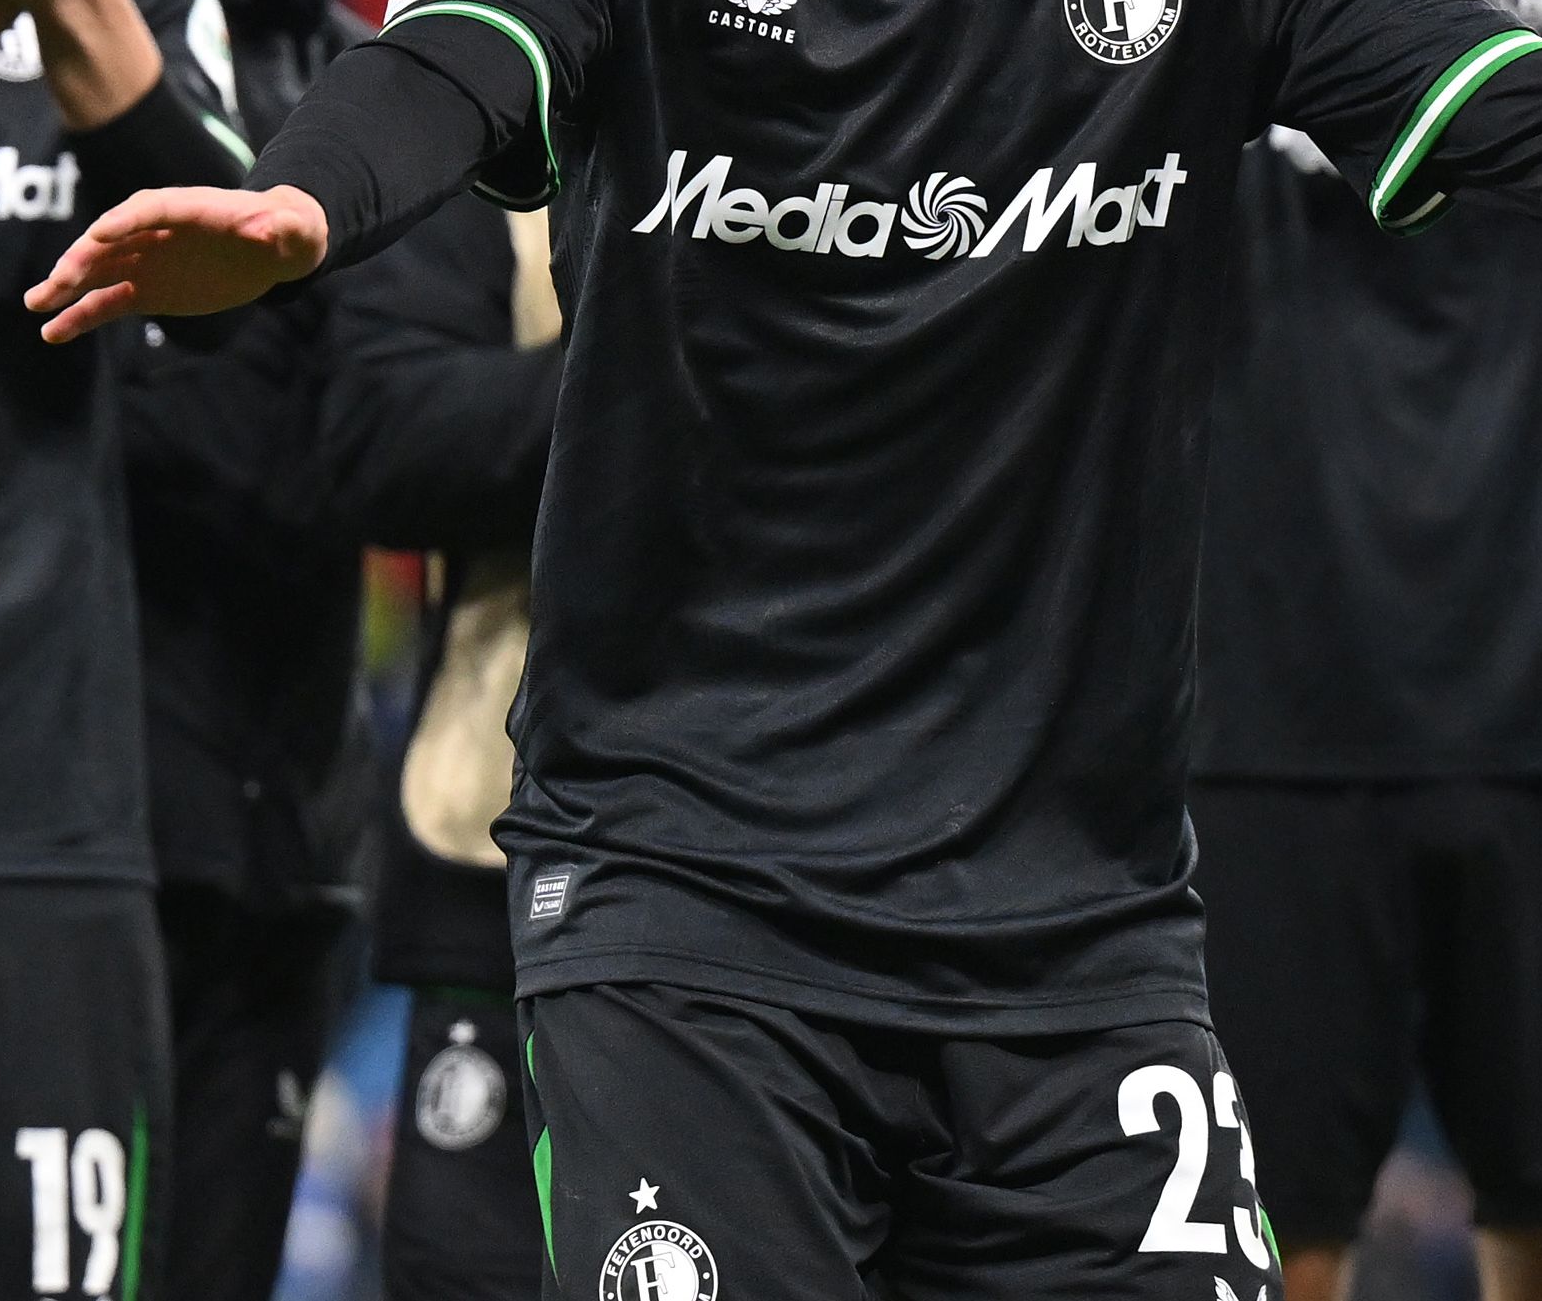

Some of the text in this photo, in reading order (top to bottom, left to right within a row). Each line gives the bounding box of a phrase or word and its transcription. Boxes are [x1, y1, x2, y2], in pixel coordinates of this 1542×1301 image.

[708, 9, 796, 44] CASTORE
[1075, 7, 1177, 59] ROTTERDAM
[631, 149, 899, 259] Media
[14, 1126, 127, 1297] 19
[606, 1225, 704, 1277] FEYENOORD
